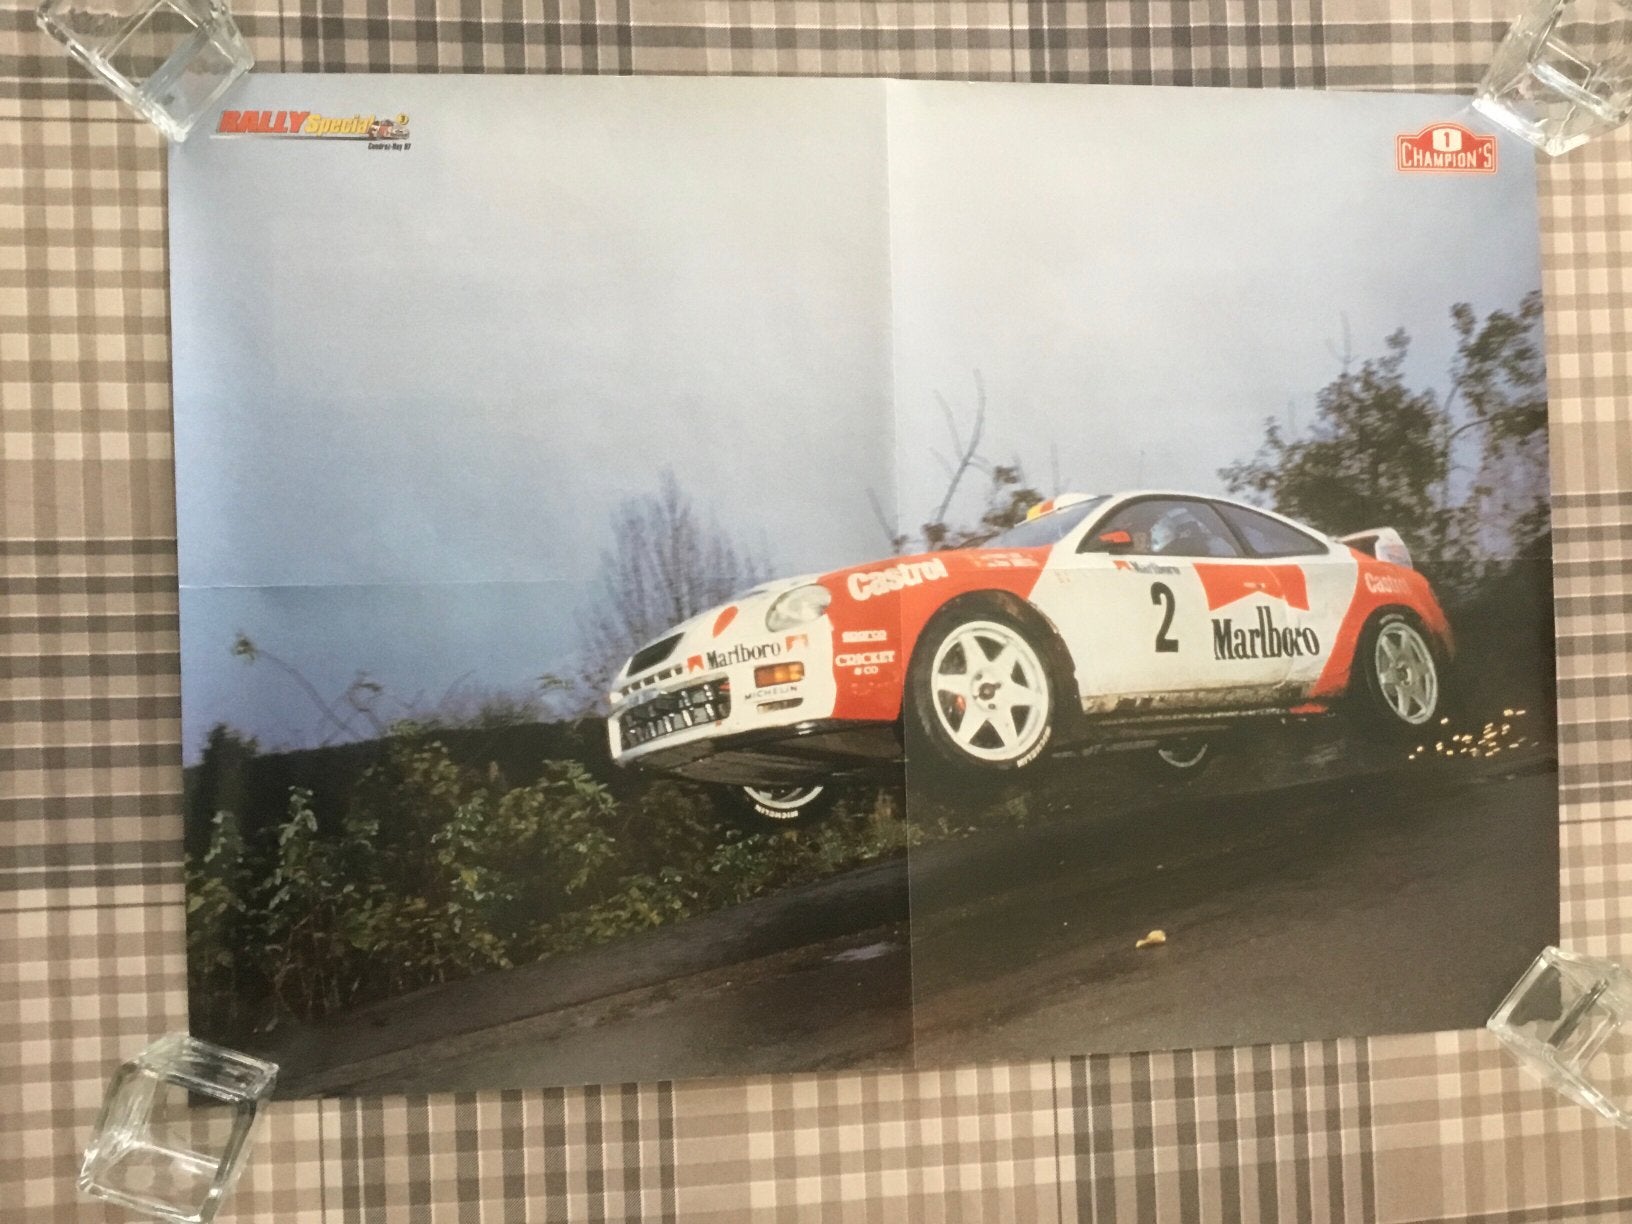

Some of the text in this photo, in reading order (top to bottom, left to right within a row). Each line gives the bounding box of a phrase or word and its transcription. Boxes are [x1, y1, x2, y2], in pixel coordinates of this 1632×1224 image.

[217, 110, 376, 137] RALLY Special
[1444, 131, 1450, 148] 1
[1401, 141, 1493, 168] CHAMPION'S
[847, 557, 948, 601] Castrol
[1150, 581, 1179, 653] 2
[1211, 605, 1320, 660] Marlboro
[706, 642, 781, 670] Marlboro
